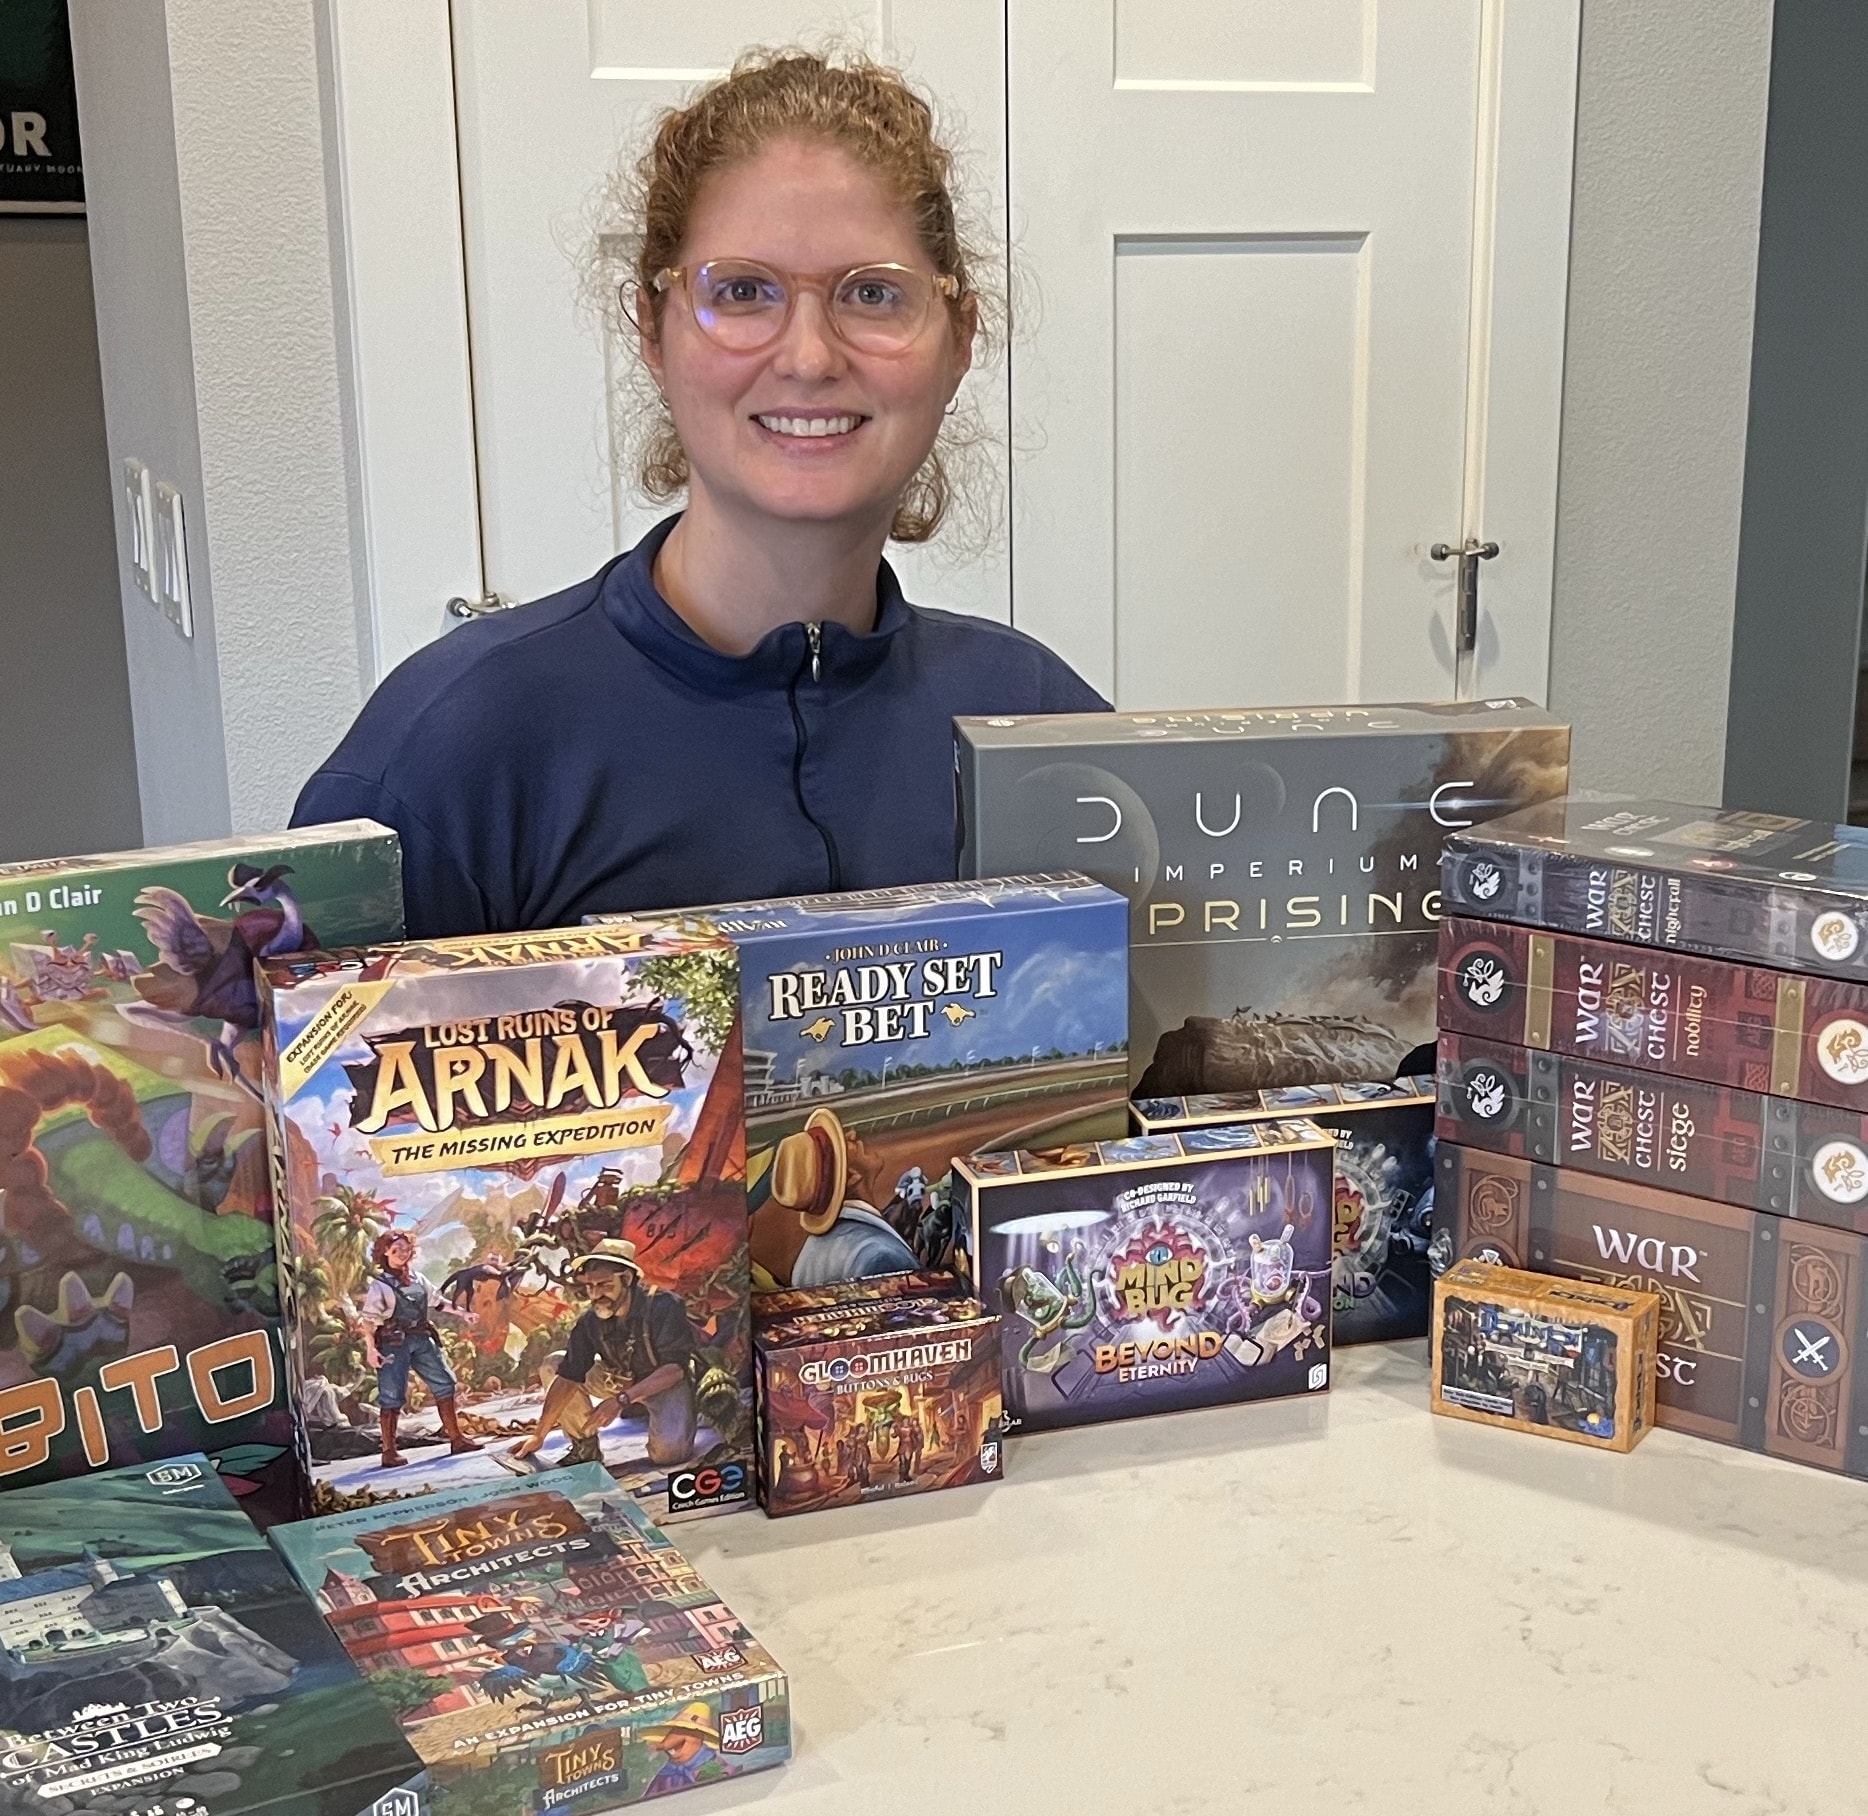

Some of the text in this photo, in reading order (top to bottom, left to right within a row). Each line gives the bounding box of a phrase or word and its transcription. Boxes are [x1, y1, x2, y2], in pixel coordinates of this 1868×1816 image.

[1134, 853, 1418, 883] IMPERIUM
[26, 891, 41, 913] D
[49, 884, 102, 909] Clair
[1149, 889, 1441, 935] PRISING
[833, 938, 939, 964] JOHN D CLAIR
[768, 951, 1003, 1020] READY SET
[1575, 963, 1604, 1044] WAR
[286, 1011, 333, 1063] EXPANSION
[424, 1005, 615, 1048] LOST RUINS OF
[840, 1000, 935, 1047] BET
[1686, 985, 1707, 1056] nobility
[357, 1023, 671, 1134] ARNAK
[1570, 1079, 1595, 1152] WAR
[392, 1119, 656, 1164] THE MISSING EXPEDITION
[1181, 1183, 1194, 1193] BY
[1116, 1257, 1203, 1291] MIND
[1592, 1224, 1701, 1284] WAR
[1125, 1281, 1194, 1316] BUG
[798, 1338, 972, 1384] GLOOMHAVEN
[1094, 1332, 1225, 1375] BEYOND
[1118, 1358, 1199, 1384] ETERNITY
[0, 1328, 278, 1483] BITO
[836, 1371, 934, 1395] BUTTONS & BUGS
[672, 1465, 744, 1499] CGE
[381, 1509, 520, 1566] TINY
[443, 1513, 568, 1563] TOWNS
[396, 1538, 591, 1599] ARCHITECTS
[701, 1651, 741, 1669] AEG
[5, 1696, 198, 1749] Between Two
[454, 1672, 744, 1749] AN EXPANSION FOR TINY TOWNS
[722, 1717, 762, 1744] AEG
[2, 1703, 223, 1769] CASTLES
[12, 1725, 232, 1786] of Mad King Ludwig
[90, 1767, 185, 1796] EXPANSION
[546, 1743, 602, 1785] TINY
[564, 1749, 615, 1784] TOWNS
[542, 1773, 620, 1810] ARCHITECTS
